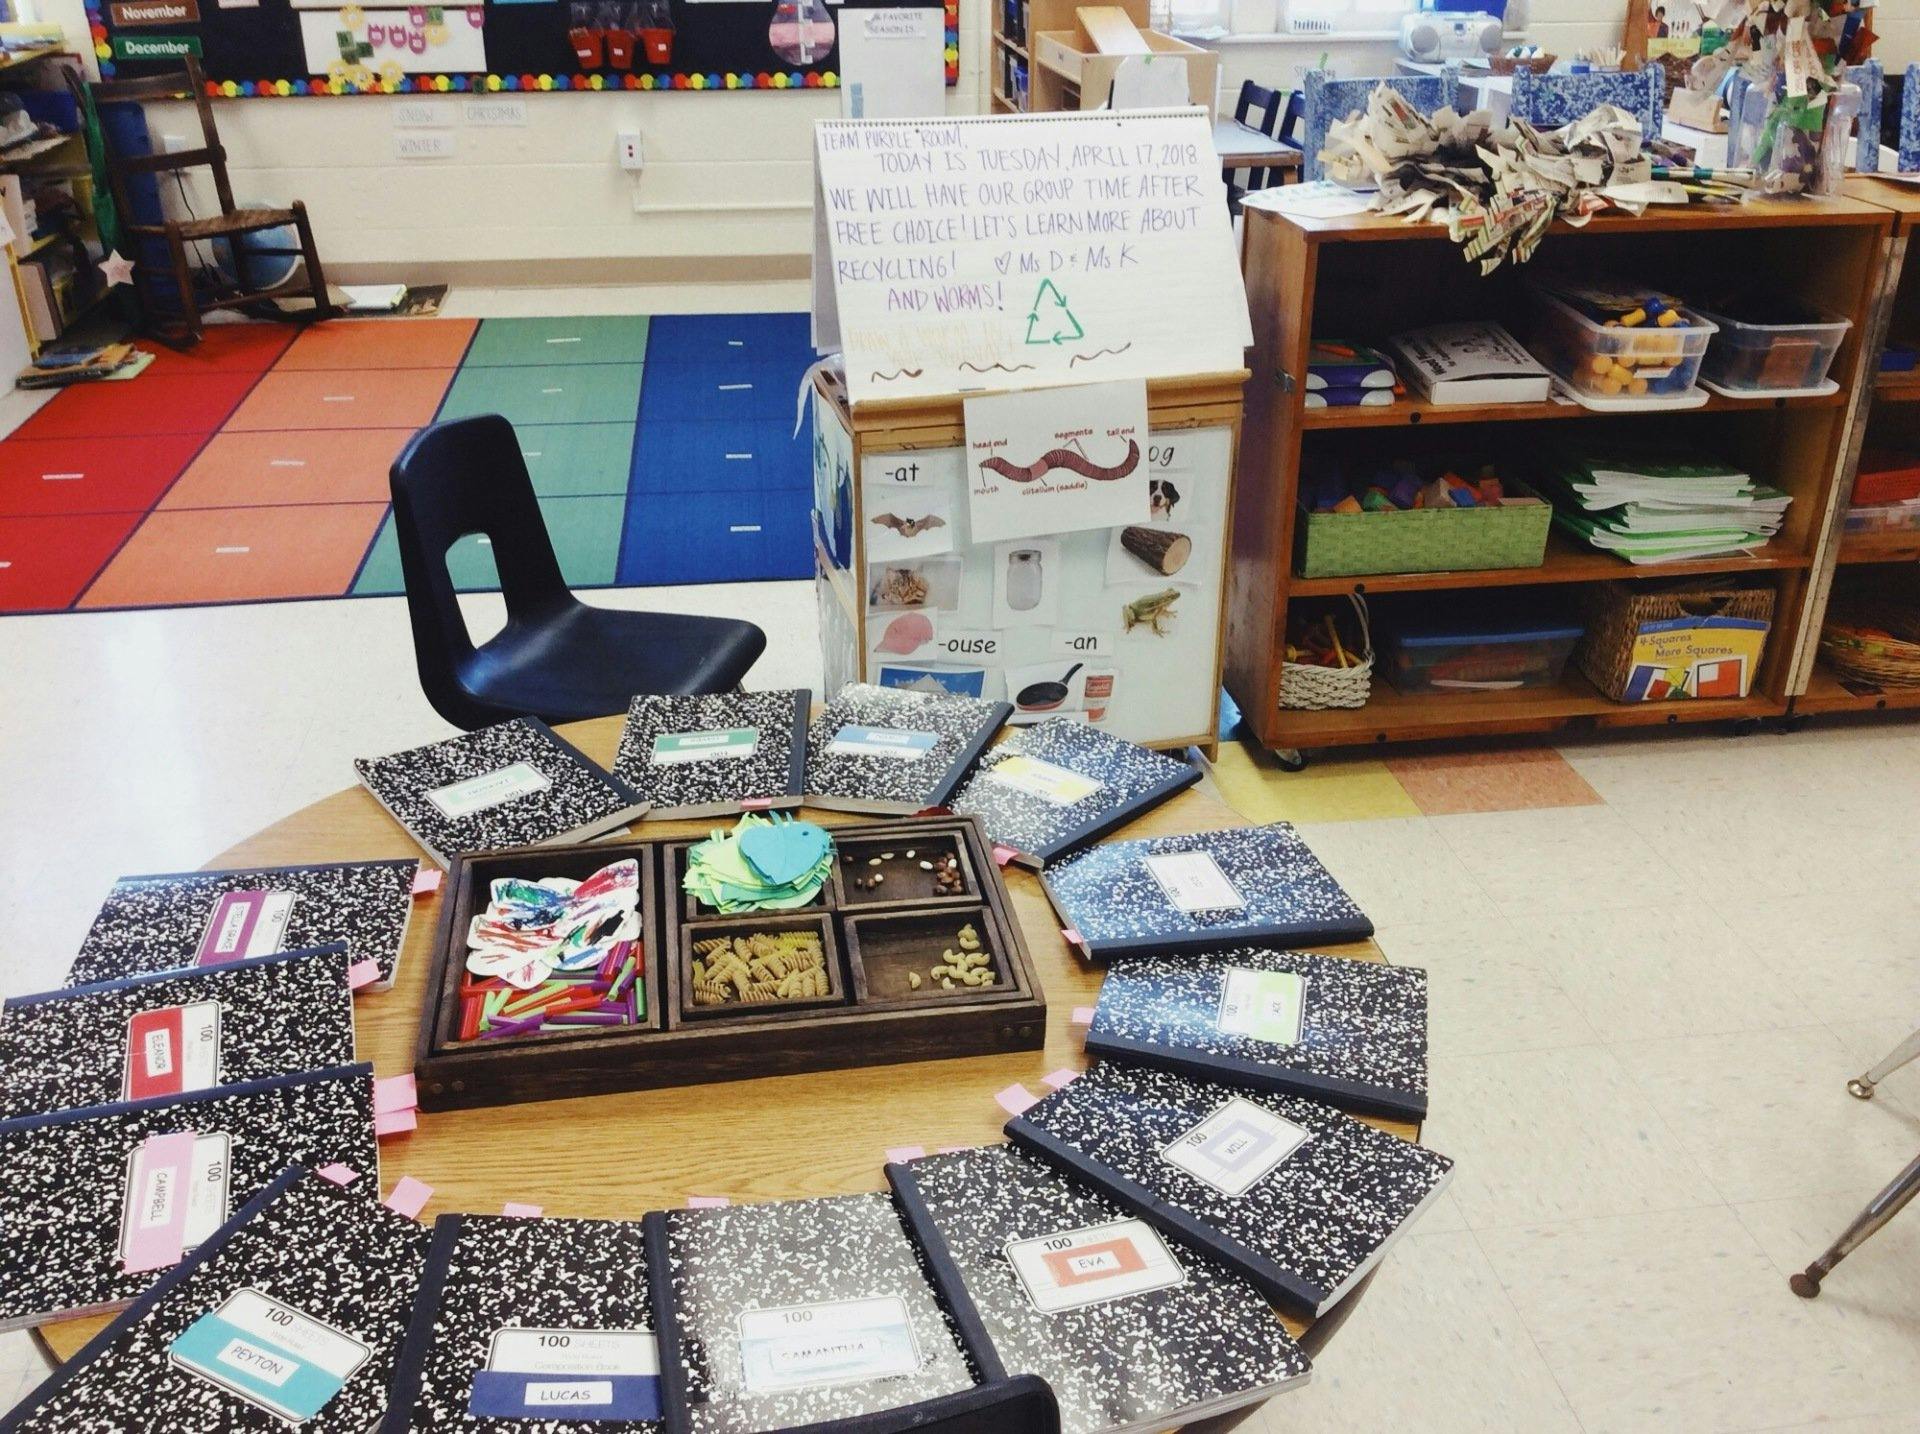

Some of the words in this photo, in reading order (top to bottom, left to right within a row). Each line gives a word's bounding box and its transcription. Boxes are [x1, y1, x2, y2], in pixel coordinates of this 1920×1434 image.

[122, 5, 187, 20] November
[125, 40, 190, 55] December
[399, 138, 441, 153] WINTER
[822, 130, 859, 151] TEAM
[865, 129, 913, 149] PURPLE
[875, 151, 932, 173] TODAY
[945, 152, 967, 171] IS
[1072, 145, 1130, 167] APRIL
[829, 188, 857, 211] WE
[866, 185, 917, 212] WILL
[925, 183, 968, 208] HAVE
[979, 182, 1018, 206] OUR
[1024, 177, 1074, 205] GROUP
[1084, 176, 1132, 200] TIME
[1138, 175, 1204, 199] AFTER
[836, 221, 883, 246] FREE
[893, 214, 966, 244] CHOICE!
[974, 214, 1017, 240] LET'S
[1026, 212, 1083, 236] LEARN
[1086, 210, 1133, 234] MORE
[1140, 207, 1200, 234] ABOUT
[838, 250, 957, 284] RECYCLING!
[1050, 250, 1064, 271] D
[1120, 243, 1139, 268] K
[888, 288, 929, 312] AND
[934, 281, 1004, 313] WORMS!
[1054, 427, 1093, 440] segments
[1107, 427, 1120, 436] tail
[1121, 426, 1135, 435] end
[973, 440, 992, 449] head
[993, 438, 1008, 447] end
[885, 462, 920, 482] -at
[974, 485, 999, 495] mouth
[1056, 481, 1088, 493] (saddle)
[938, 639, 996, 654] -ouse
[1065, 636, 1097, 650] -an
[1648, 633, 1692, 649] Squares
[1685, 644, 1733, 659] Squares
[200, 1024, 214, 1042] 100
[1186, 1132, 1208, 1148] 100
[1224, 1138, 1249, 1156] WILL
[208, 1161, 222, 1182] 100
[150, 1172, 168, 1221] CAMPBELL
[1043, 1237, 1072, 1251] 100
[1078, 1256, 1106, 1269] EVA
[264, 1307, 294, 1327] 100
[783, 1310, 813, 1324] 100
[538, 1335, 570, 1348] 100
[231, 1345, 285, 1375] PEYTON
[540, 1390, 592, 1401] LUCAS
